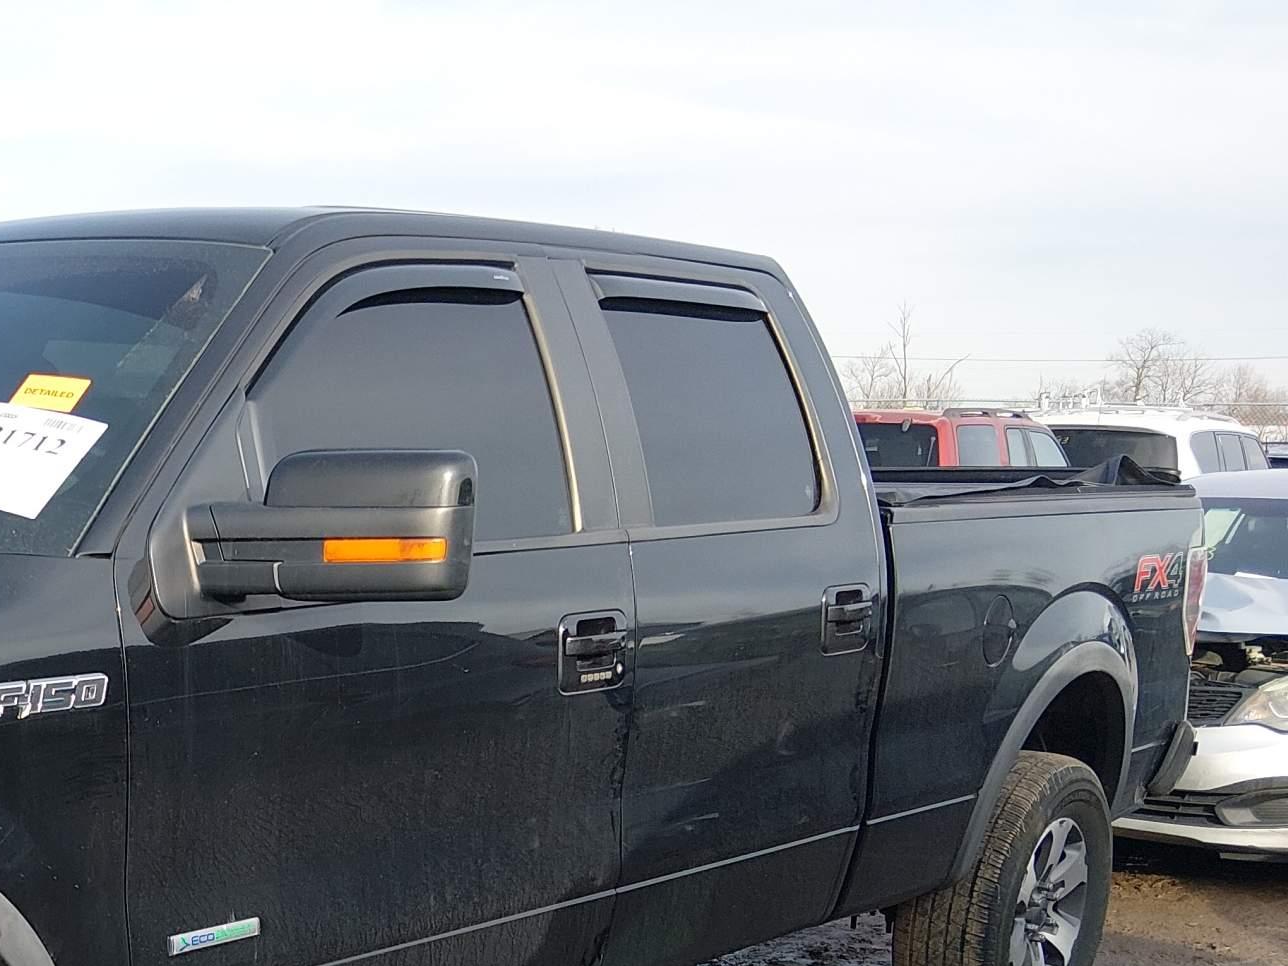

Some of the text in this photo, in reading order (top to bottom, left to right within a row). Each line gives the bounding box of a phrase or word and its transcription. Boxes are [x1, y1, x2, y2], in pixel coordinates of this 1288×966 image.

[23, 386, 74, 399] DETAILED
[1134, 552, 1183, 593] FX4
[1132, 589, 1179, 602] OFF ROAD
